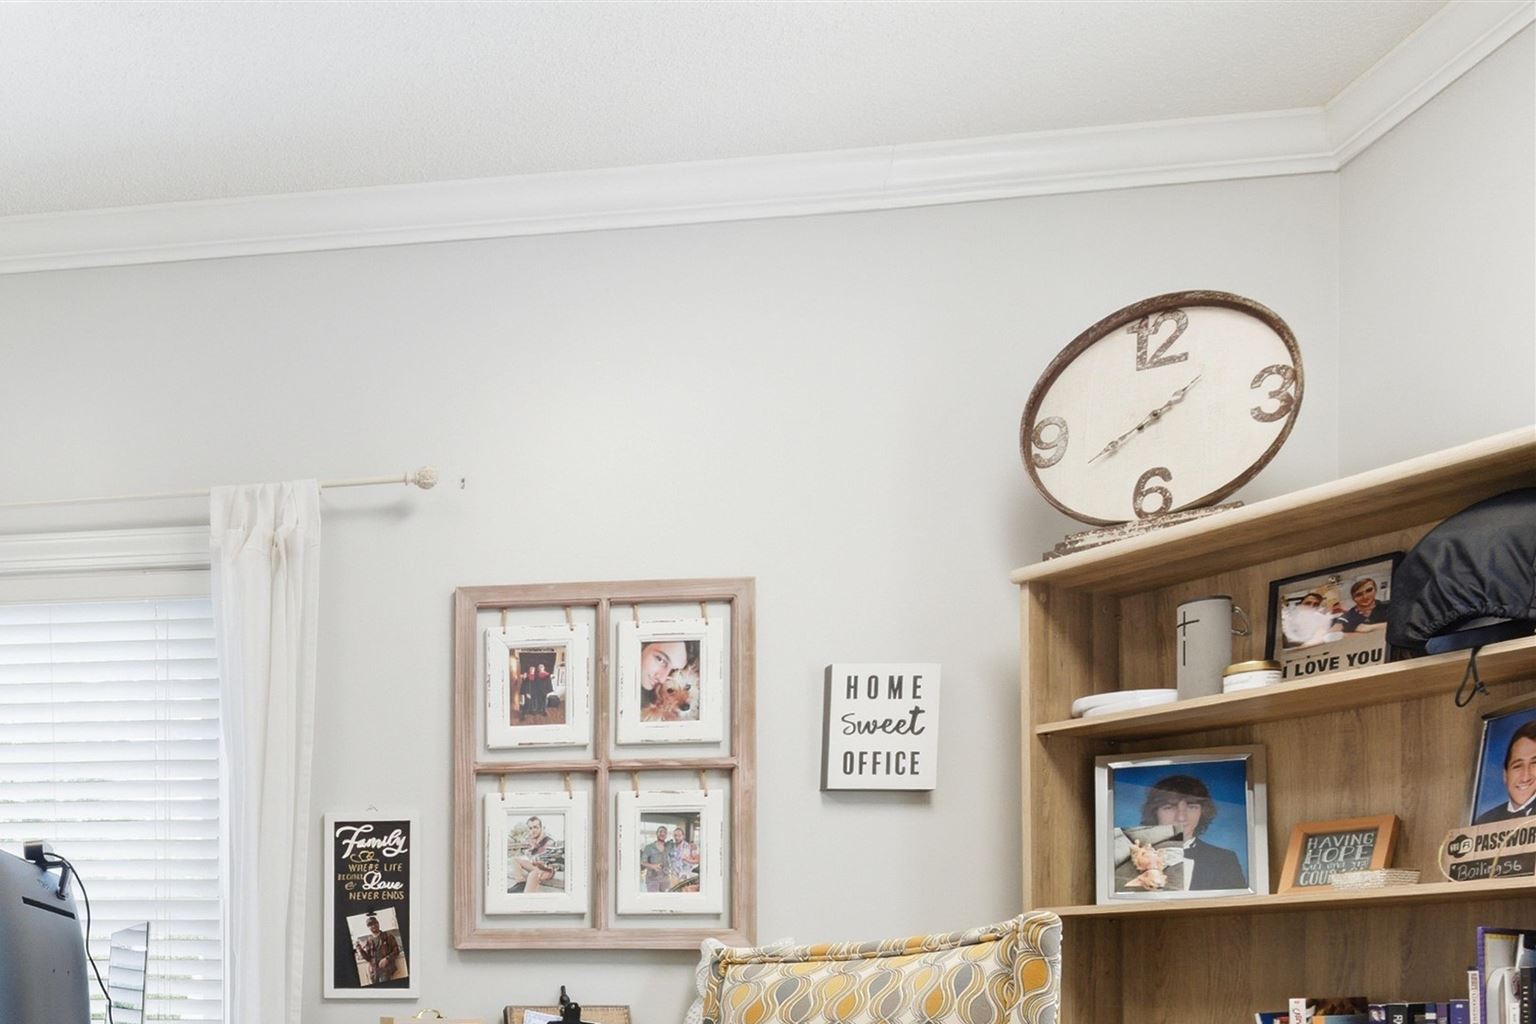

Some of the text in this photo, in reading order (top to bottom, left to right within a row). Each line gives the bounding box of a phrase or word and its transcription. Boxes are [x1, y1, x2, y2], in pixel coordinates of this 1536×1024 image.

[1126, 309, 1189, 371] 12
[1250, 364, 1297, 423] 3
[1031, 416, 1069, 469] 9
[1133, 467, 1172, 520] 6
[1282, 648, 1382, 678] I LOVE YOU
[846, 675, 923, 700] HOME
[841, 705, 926, 735] Sweet
[842, 751, 920, 775] OFFICE
[335, 824, 409, 859] Family
[1304, 844, 1371, 864] HOPE
[1307, 832, 1374, 850] HAVING
[348, 890, 405, 900] NEVER ENDS
[362, 870, 404, 890] Love
